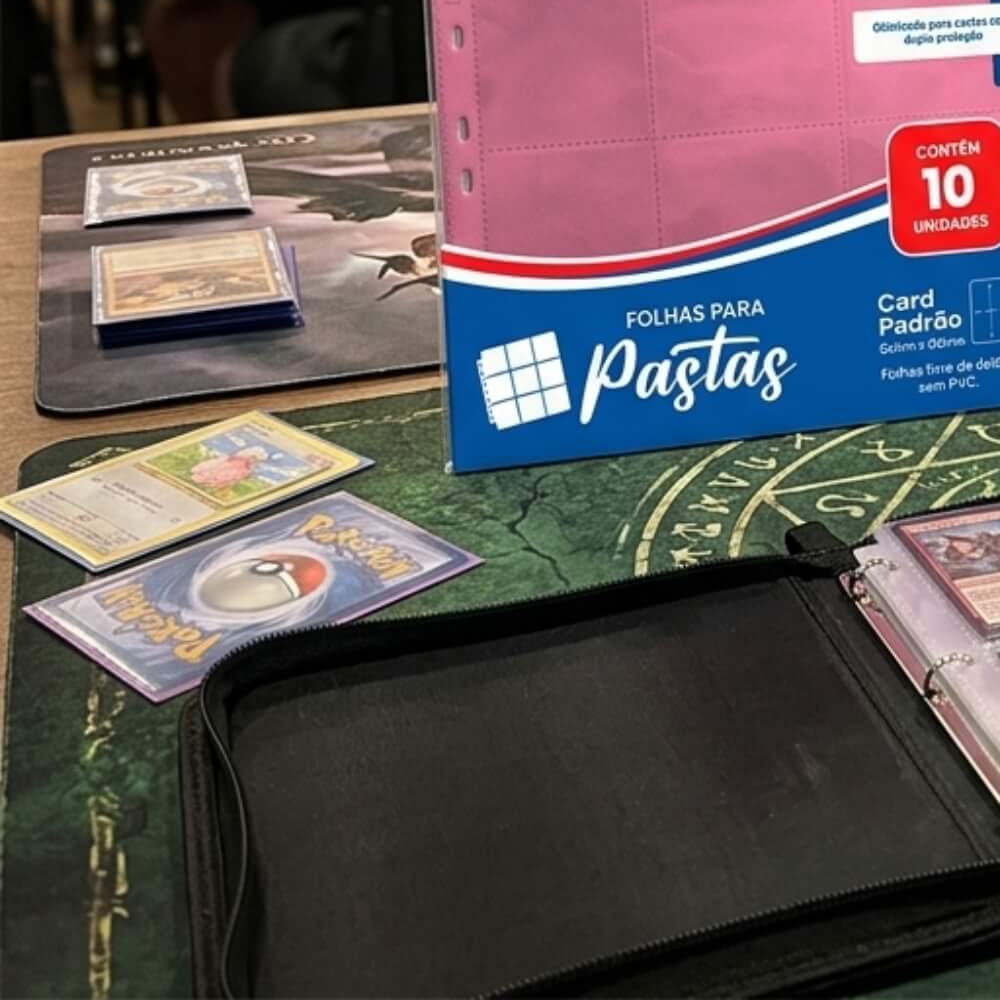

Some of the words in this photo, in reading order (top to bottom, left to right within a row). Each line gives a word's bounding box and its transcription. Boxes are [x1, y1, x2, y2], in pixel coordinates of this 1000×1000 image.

[916, 138, 981, 159] CONTÉM
[921, 164, 975, 210] 10
[626, 304, 705, 329] FOLHAS
[710, 298, 765, 320] PARA
[877, 288, 935, 313] Card
[879, 310, 962, 337] Padrão
[579, 324, 798, 425] Pastas
[956, 359, 973, 372] de
[918, 381, 946, 393] sem
